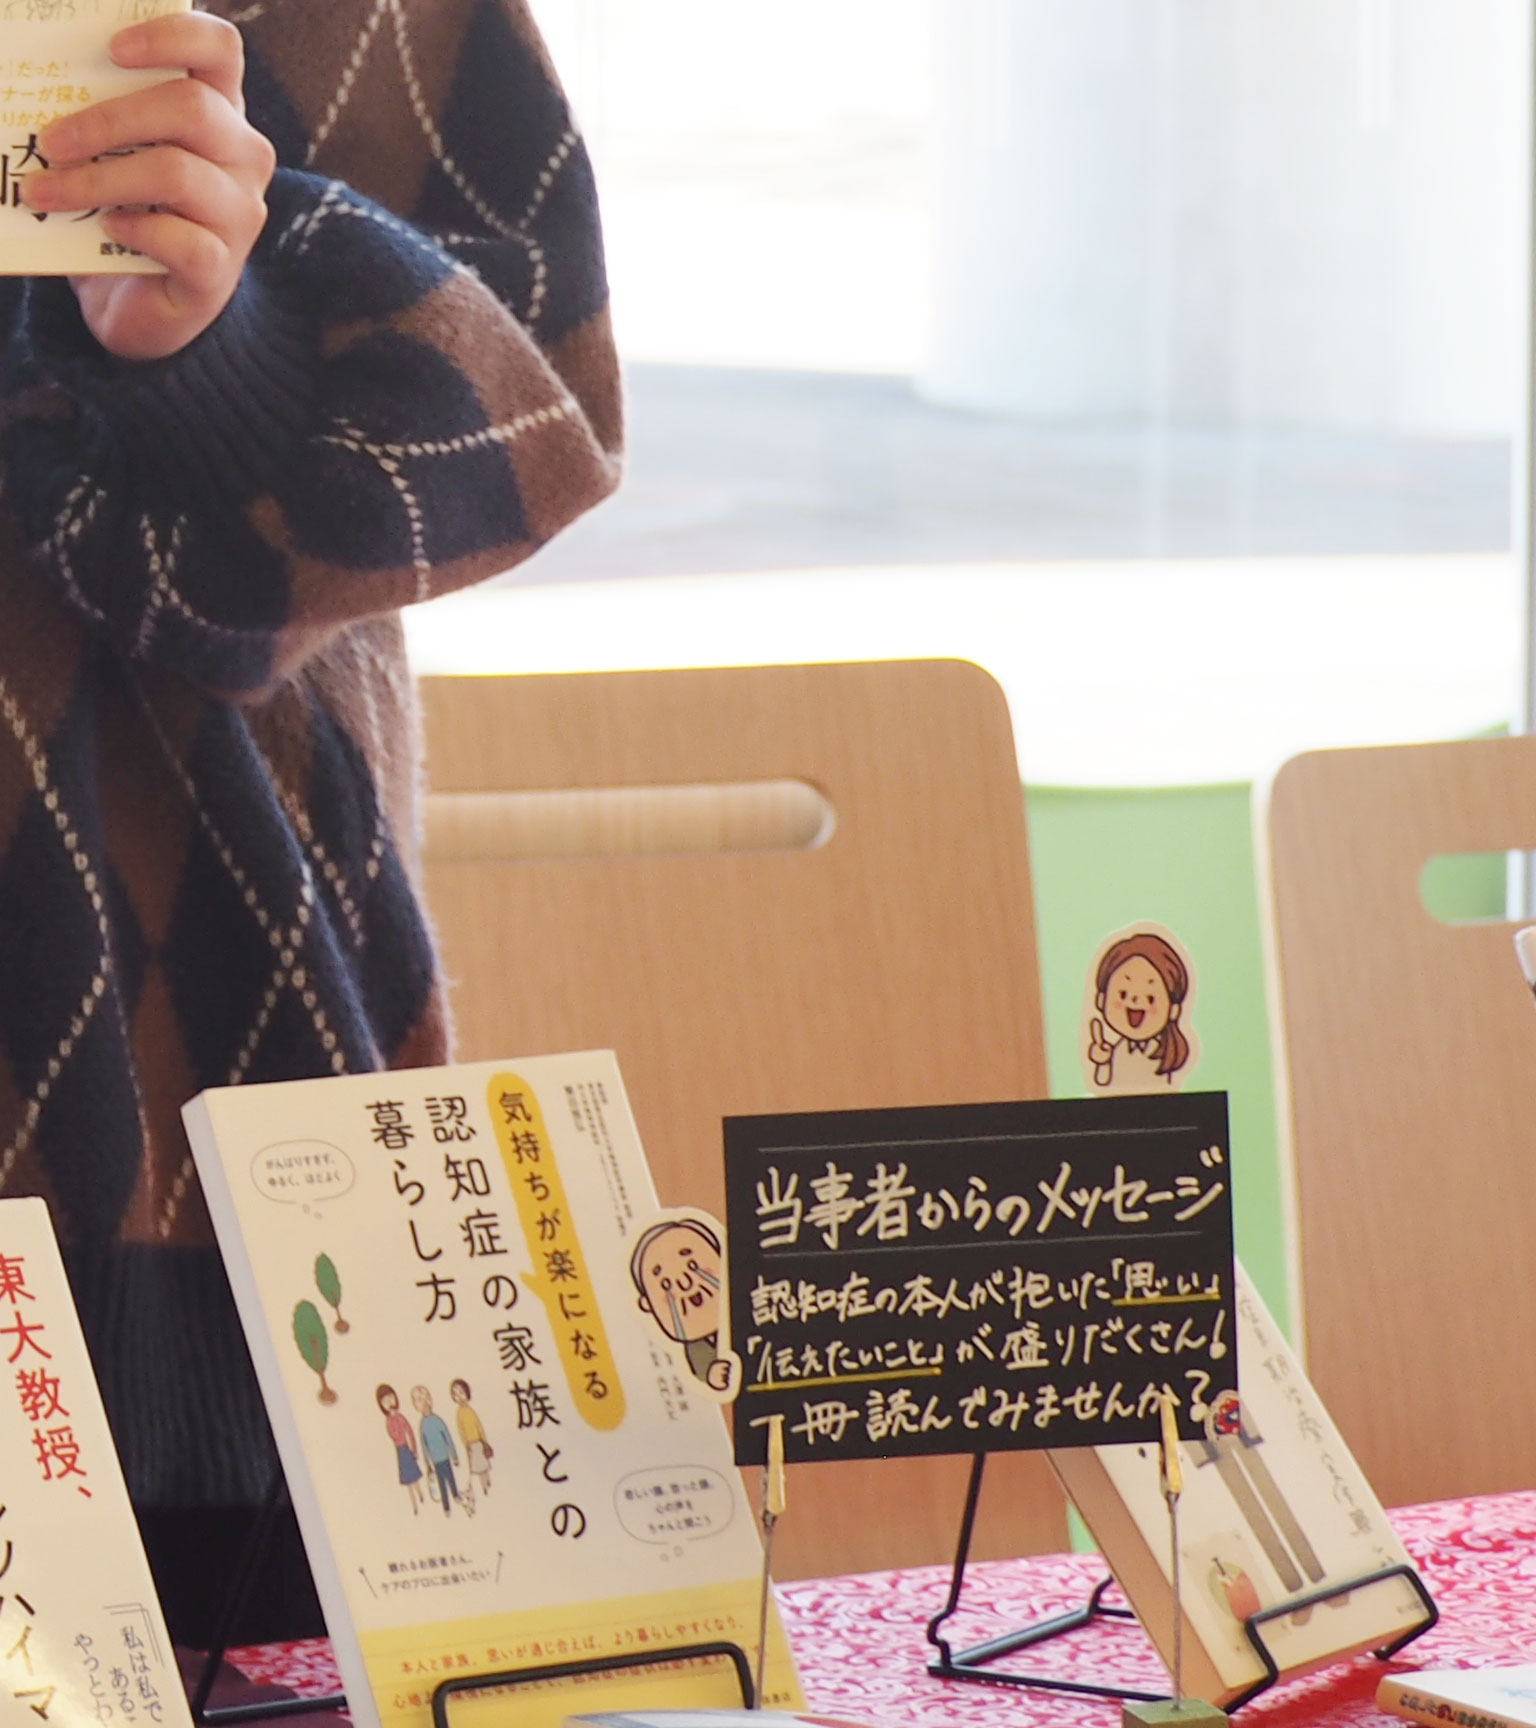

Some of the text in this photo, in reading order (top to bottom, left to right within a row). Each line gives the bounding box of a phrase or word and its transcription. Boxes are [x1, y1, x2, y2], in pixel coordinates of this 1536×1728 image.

[365, 1100, 459, 1323] 暮らし方
[499, 1091, 609, 1401] 気持ちが楽になる
[756, 1145, 1224, 1250] 当事者からのメッセージ
[425, 1096, 588, 1540] 認知症の家族との
[747, 1309, 1227, 1385] 「伝えたいこと」が盛りだくさん！
[750, 1258, 1221, 1325] 認知症の本人が抱いた「思い」
